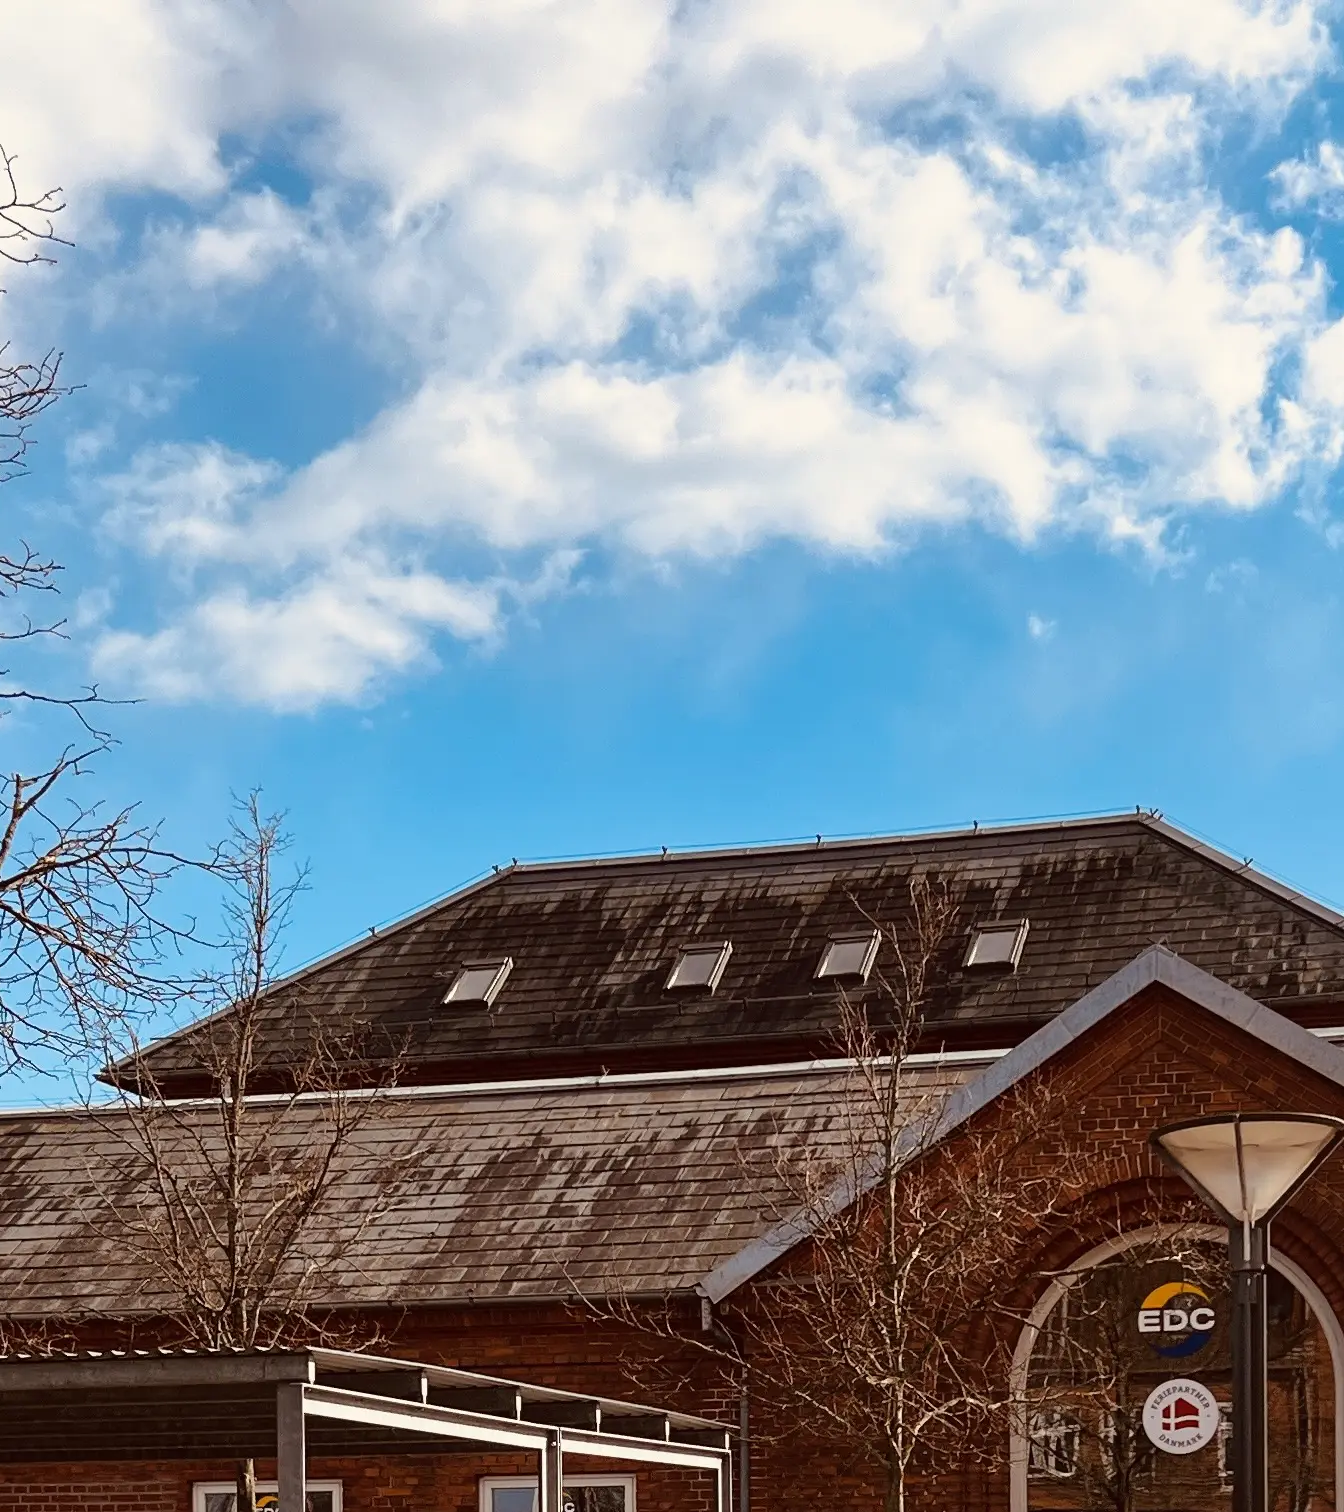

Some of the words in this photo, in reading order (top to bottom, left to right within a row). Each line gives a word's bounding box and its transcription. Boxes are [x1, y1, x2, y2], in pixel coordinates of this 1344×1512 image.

[1138, 1307, 1215, 1333] EDC
[1151, 1386, 1210, 1410] FERIEPARTNER
[1158, 1433, 1203, 1448] DANMARK
